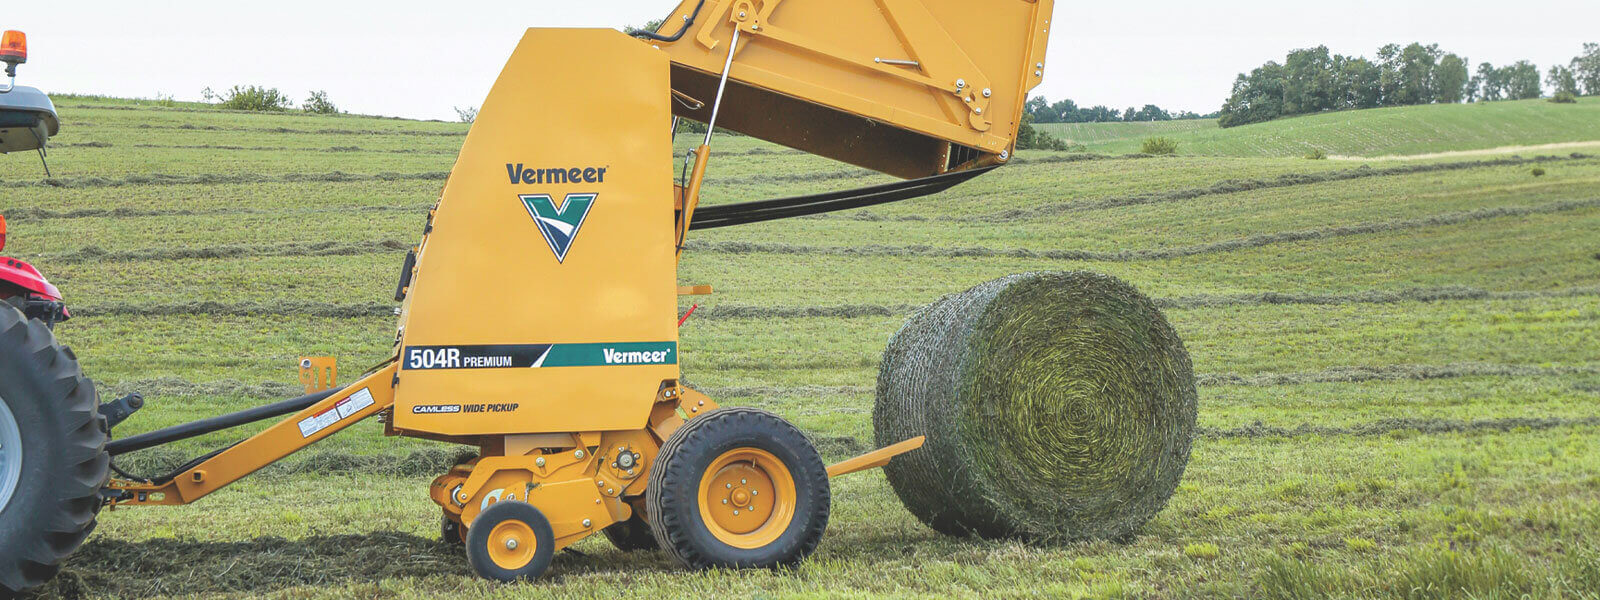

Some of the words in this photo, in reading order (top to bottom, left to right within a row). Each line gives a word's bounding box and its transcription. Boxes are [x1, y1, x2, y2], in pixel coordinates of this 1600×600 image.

[506, 163, 606, 184] Vermeer
[410, 348, 460, 369] 504R
[463, 356, 512, 367] PREMIUM
[603, 348, 667, 363] Vermeer
[413, 405, 460, 413] CAMLESS
[463, 404, 485, 413] WIDE
[487, 403, 519, 412] PICKUP
